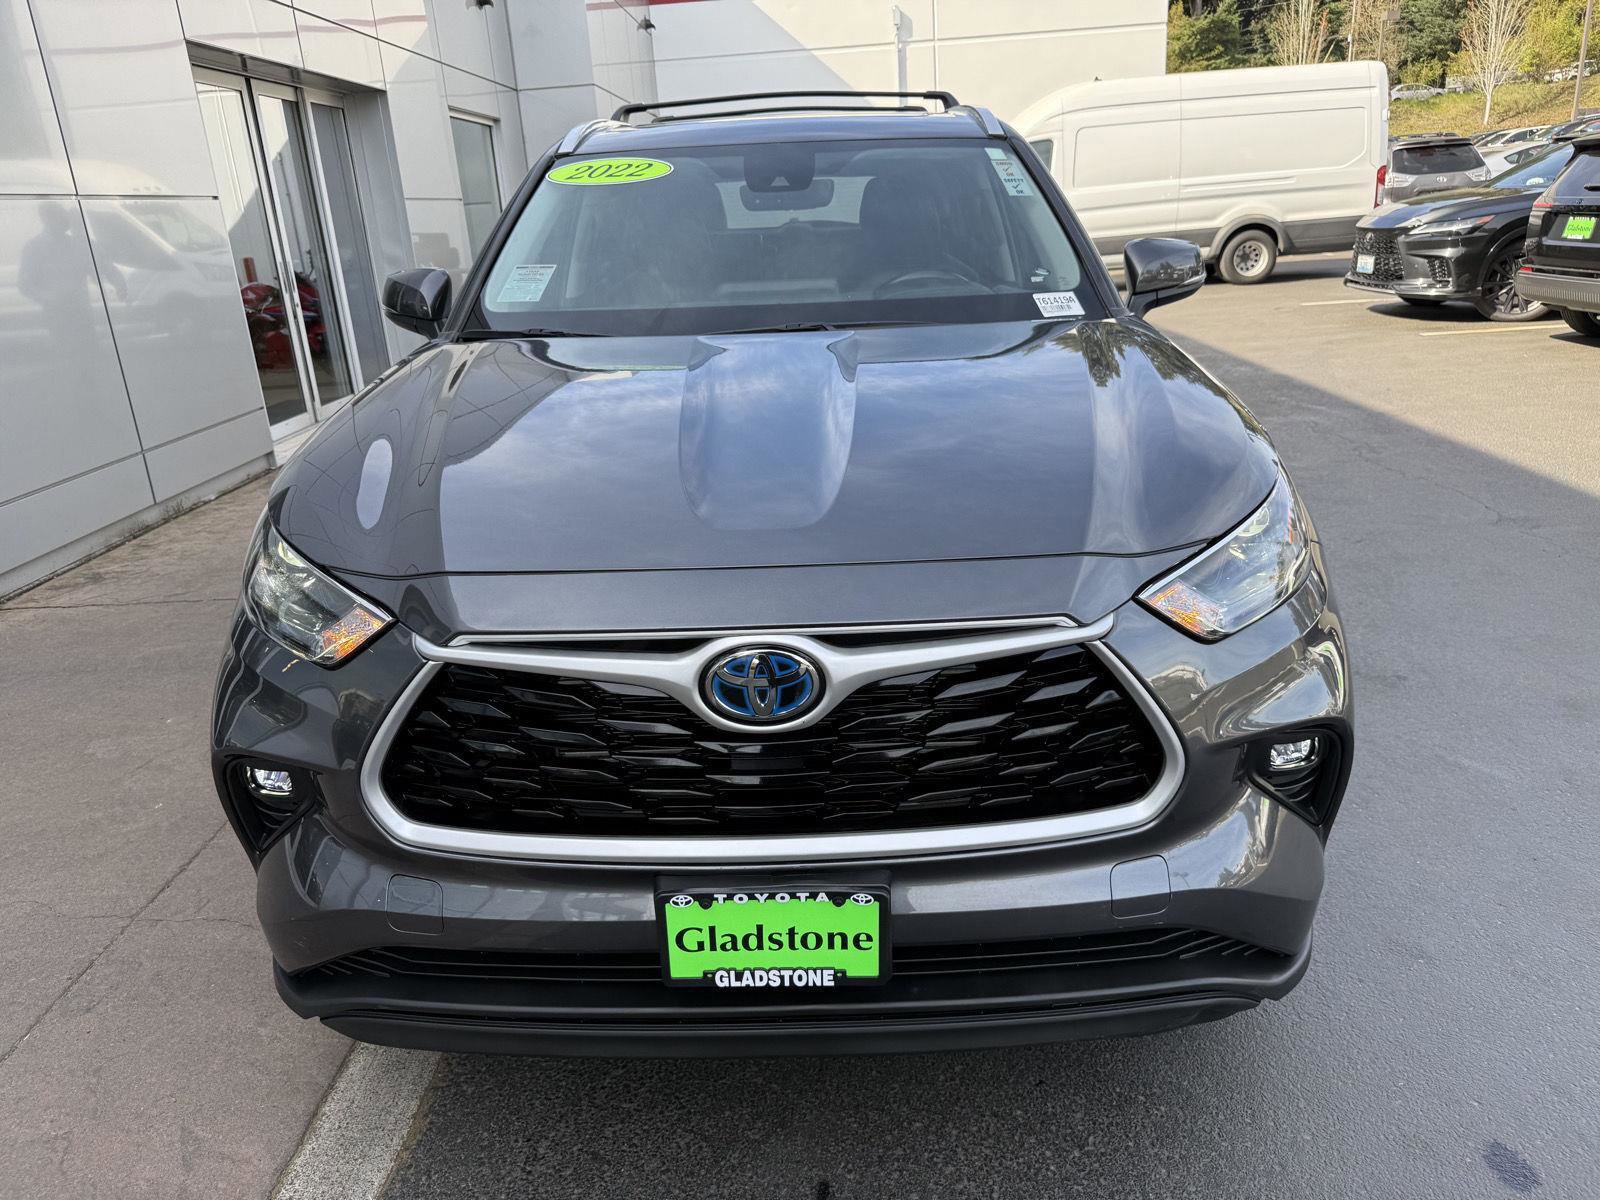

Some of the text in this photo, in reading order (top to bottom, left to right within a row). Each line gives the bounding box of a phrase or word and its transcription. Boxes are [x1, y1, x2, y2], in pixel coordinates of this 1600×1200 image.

[565, 163, 653, 180] 2022
[713, 892, 833, 904] TOYOTA
[674, 923, 874, 953] Gladstone
[714, 969, 835, 988] GLADSTONE
